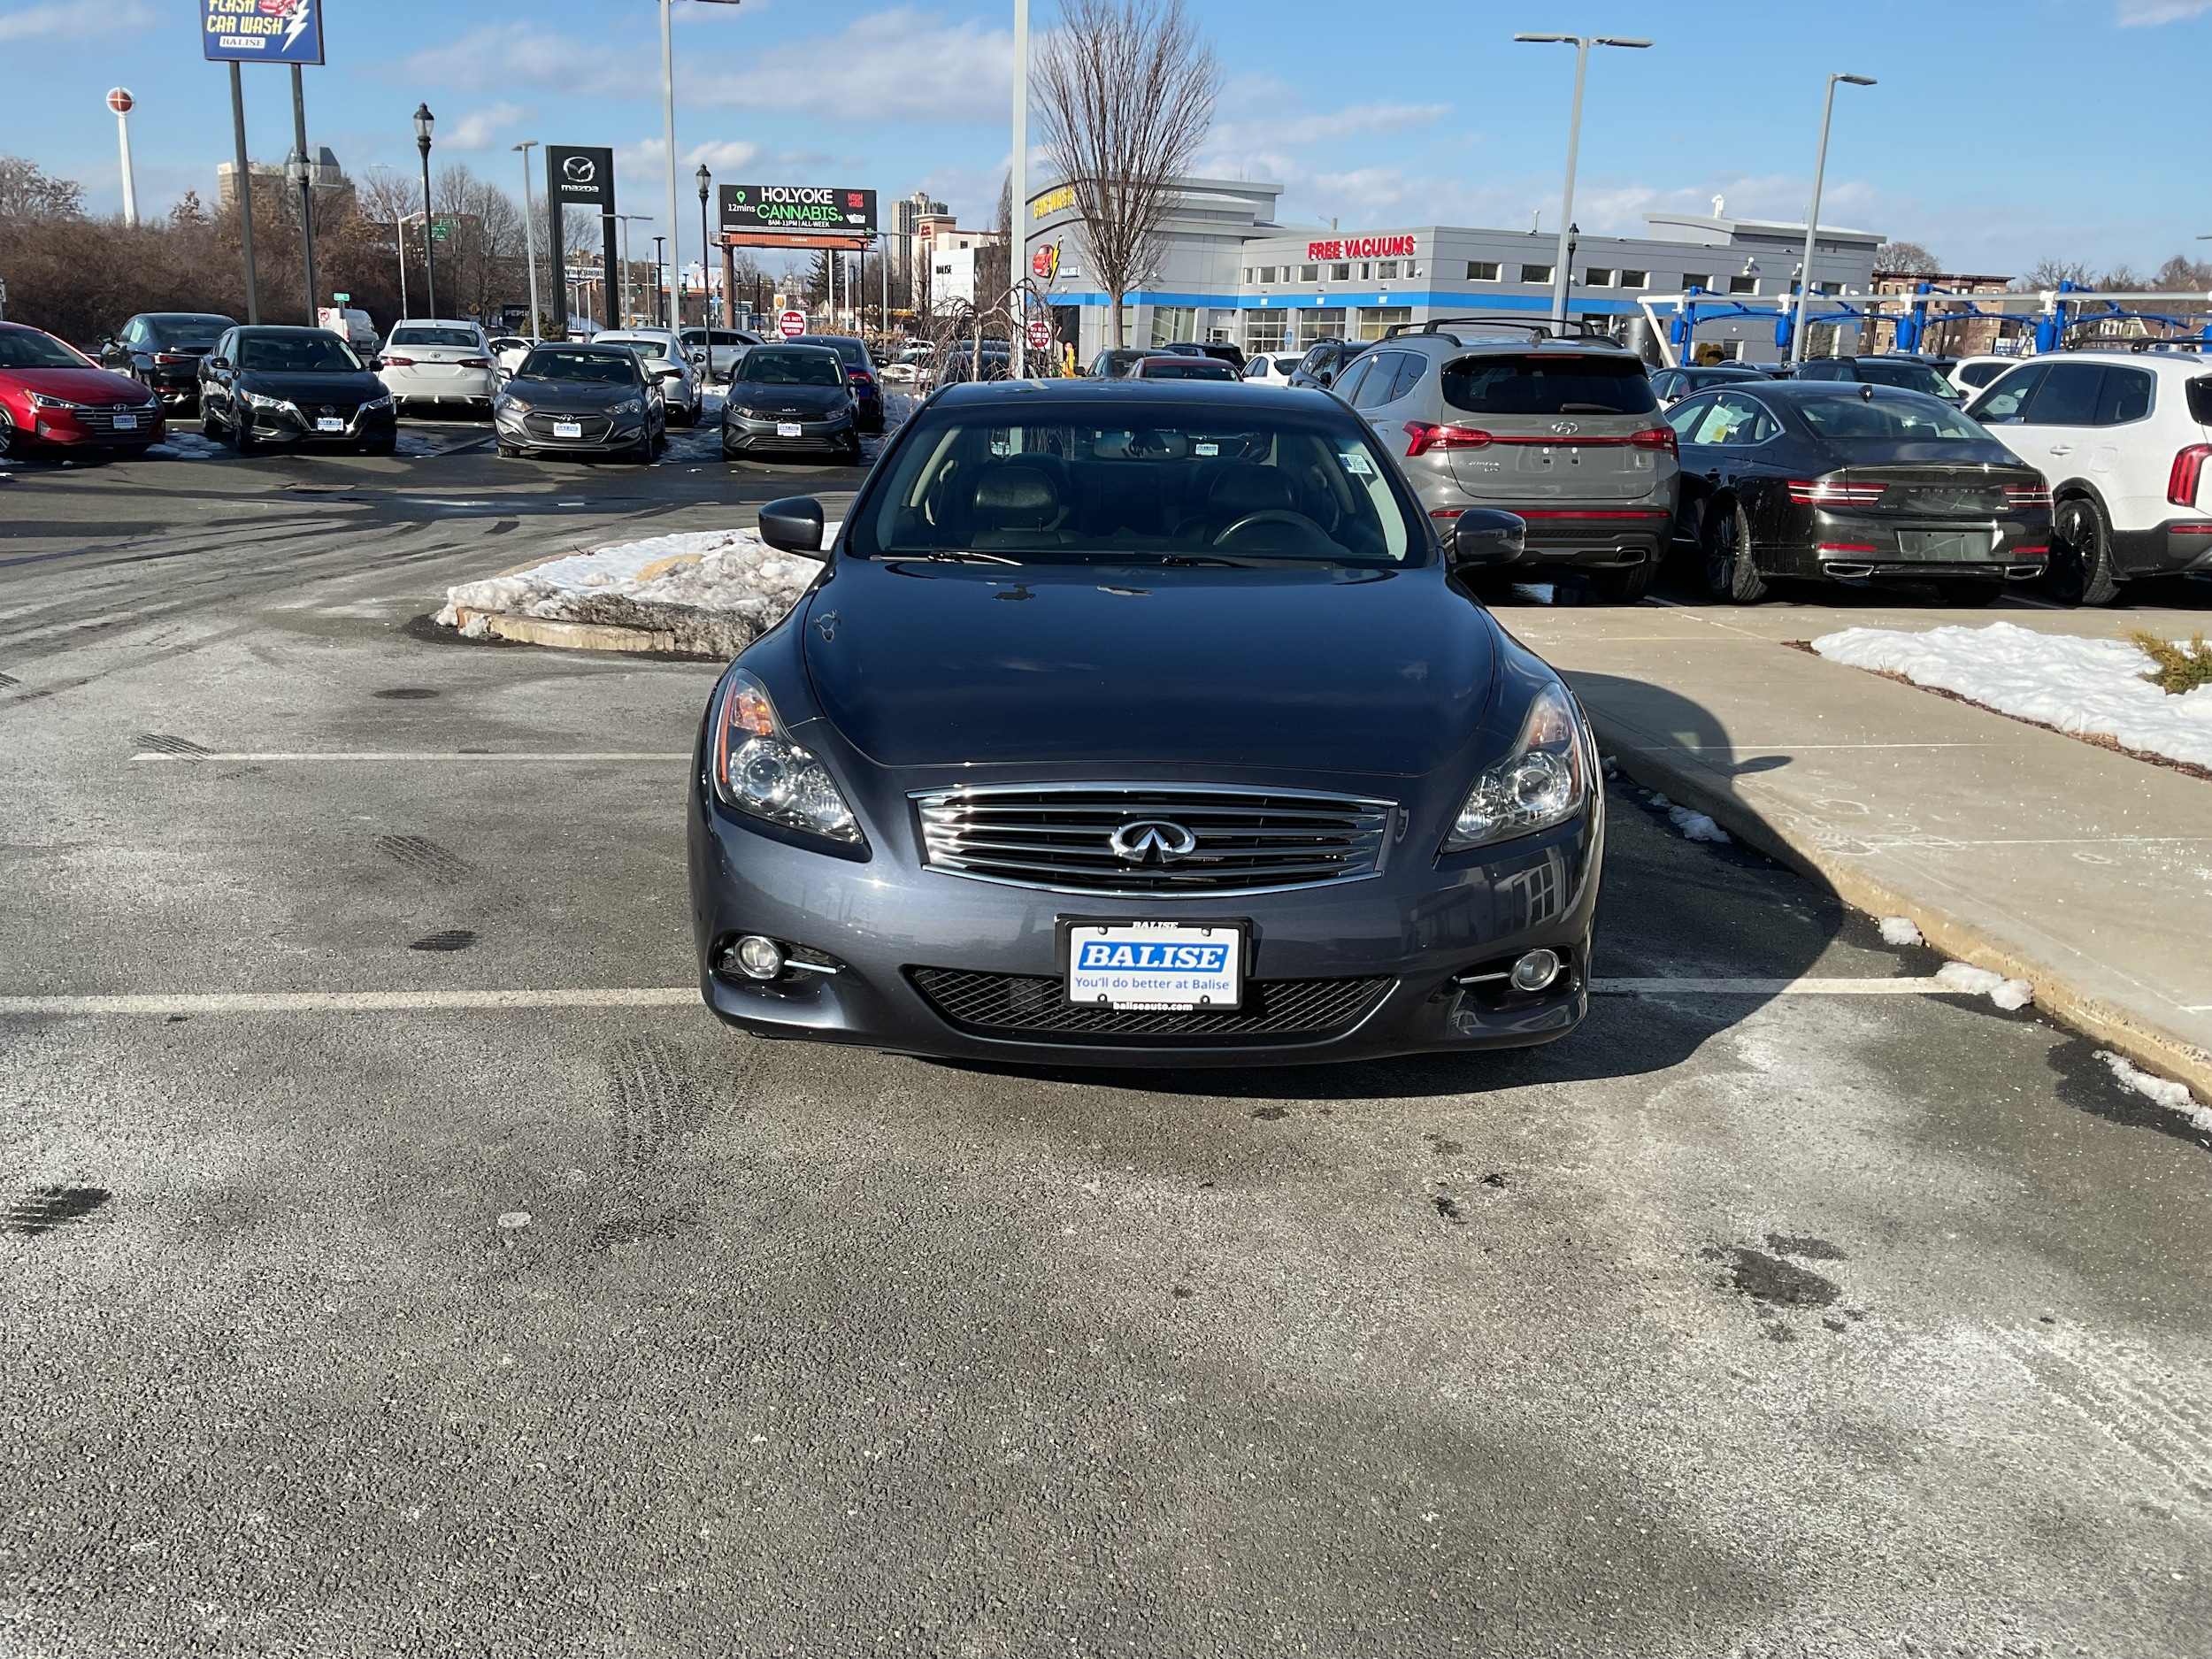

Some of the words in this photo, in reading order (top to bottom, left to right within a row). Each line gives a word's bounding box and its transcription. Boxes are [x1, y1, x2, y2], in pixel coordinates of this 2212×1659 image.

[206, 15, 237, 34] CAR
[240, 16, 283, 35] WASH
[221, 37, 264, 47] BALISE
[561, 184, 600, 193] mazda
[761, 187, 833, 204] HOLYOKE
[728, 204, 756, 213] 12mins
[1033, 196, 1049, 219] CAR
[1050, 185, 1073, 212] WASH
[1309, 241, 1341, 259] FREE
[1344, 235, 1416, 257] VACUUMS
[1083, 945, 1224, 969] BALISE
[1075, 977, 1109, 987] You'll
[1112, 978, 1129, 988] do
[1132, 978, 1172, 989] better
[1175, 979, 1189, 989] at
[1193, 979, 1230, 990] Balise
[1113, 1002, 1194, 1011] baliseauto.com
